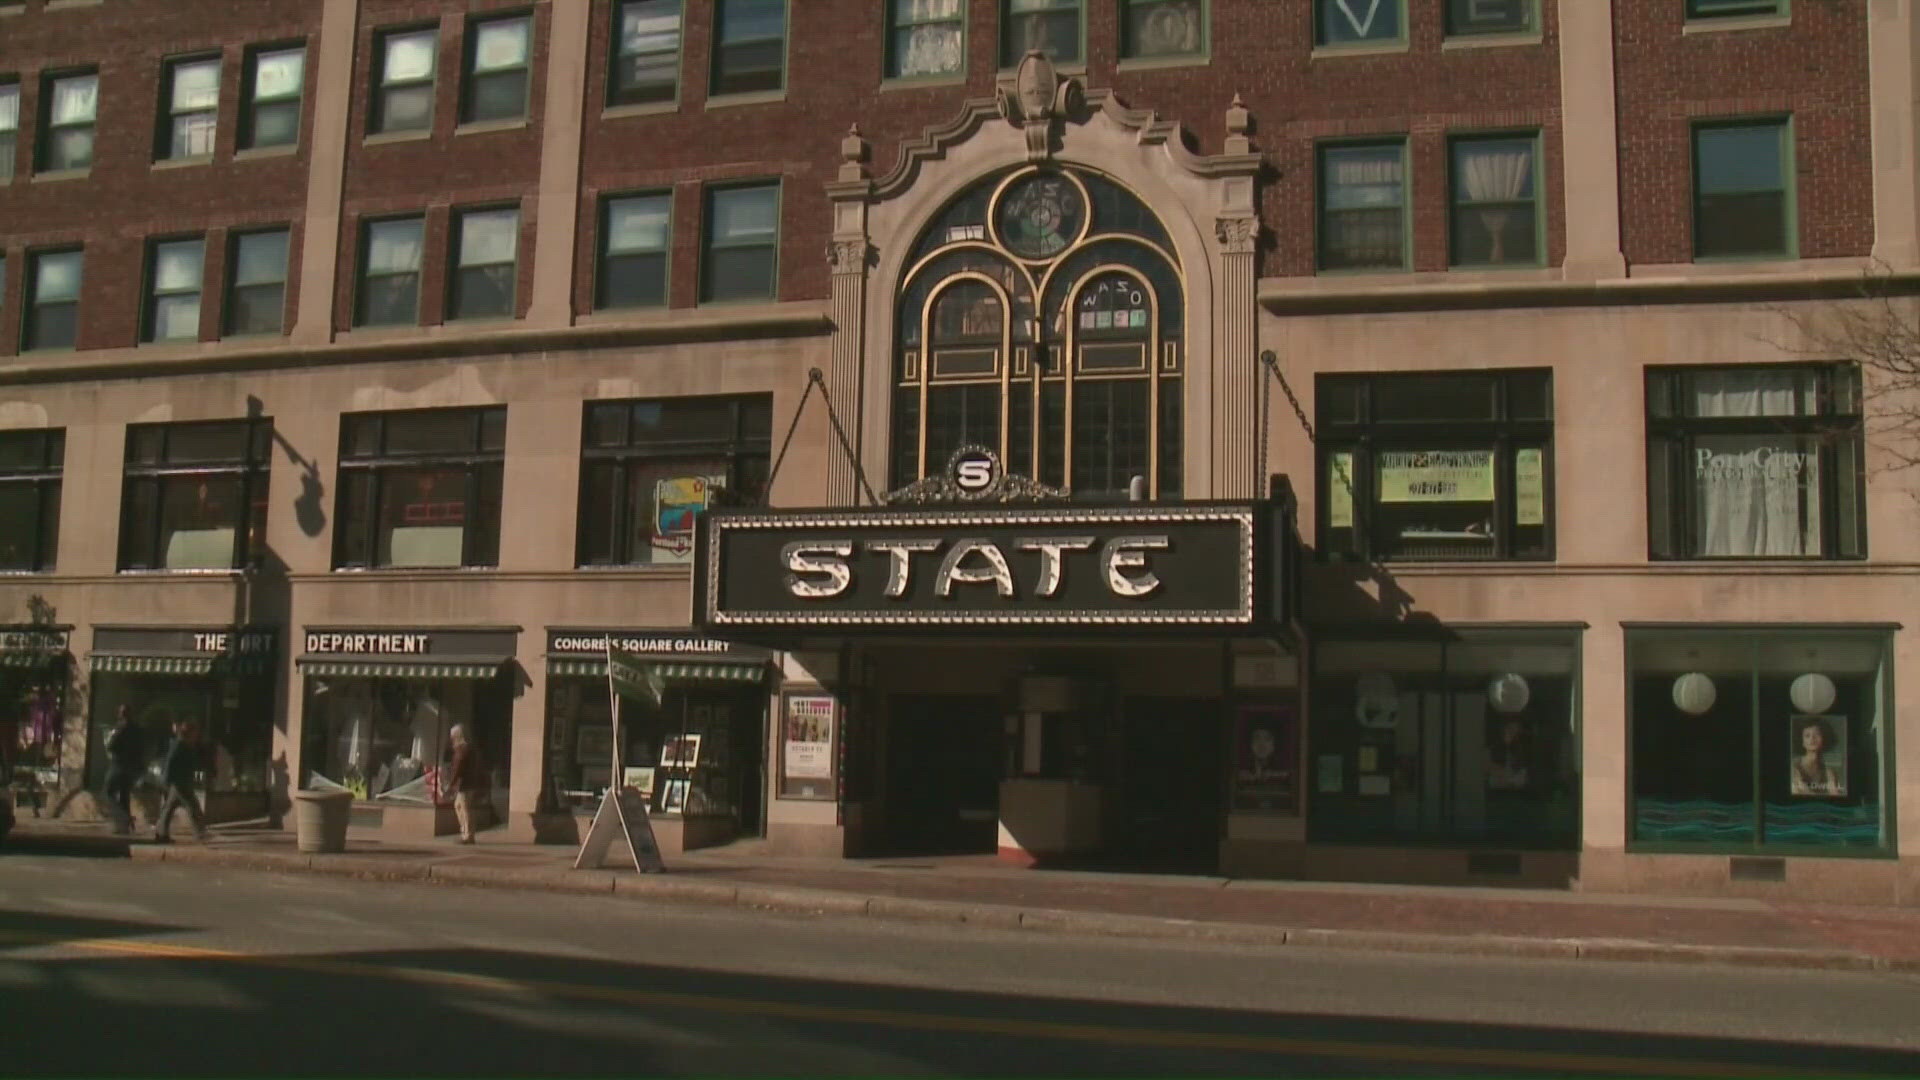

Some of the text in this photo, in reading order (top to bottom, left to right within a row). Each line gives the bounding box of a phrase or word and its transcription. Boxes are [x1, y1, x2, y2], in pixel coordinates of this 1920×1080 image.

[1754, 446, 1806, 475] City
[957, 459, 991, 488] S
[780, 534, 1169, 598] STATE
[194, 633, 273, 651] THE ART
[307, 634, 428, 653] DEPARTMENT
[622, 638, 672, 651] SQUARE
[675, 639, 730, 653] GALLERY
